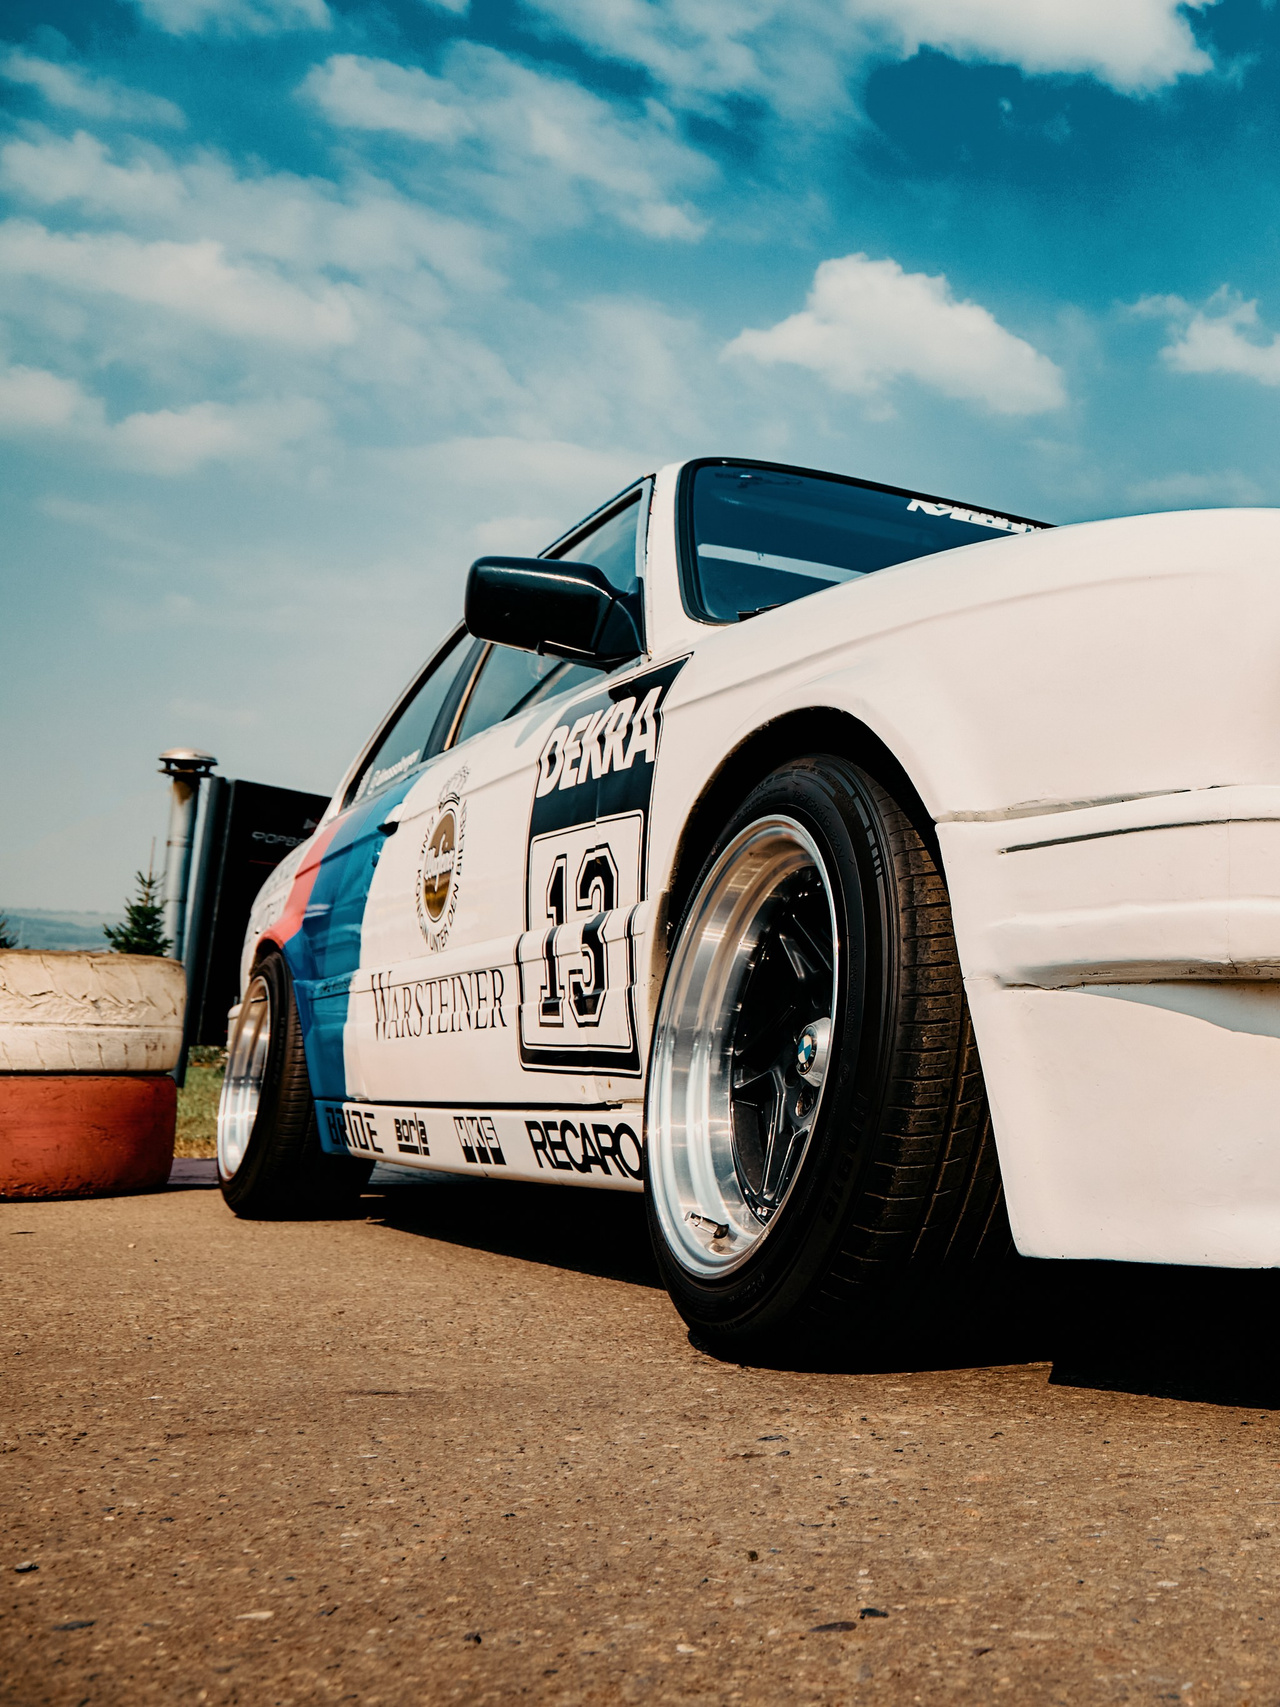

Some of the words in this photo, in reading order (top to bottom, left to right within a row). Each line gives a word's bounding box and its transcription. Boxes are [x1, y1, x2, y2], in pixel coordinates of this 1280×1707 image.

[536, 686, 663, 798] DEKRA
[539, 842, 619, 1028] 13
[371, 968, 508, 1041] WARSTEINER
[325, 1107, 385, 1154] BRIDE
[453, 1116, 504, 1158] HKS
[524, 1119, 644, 1181] RECARO
